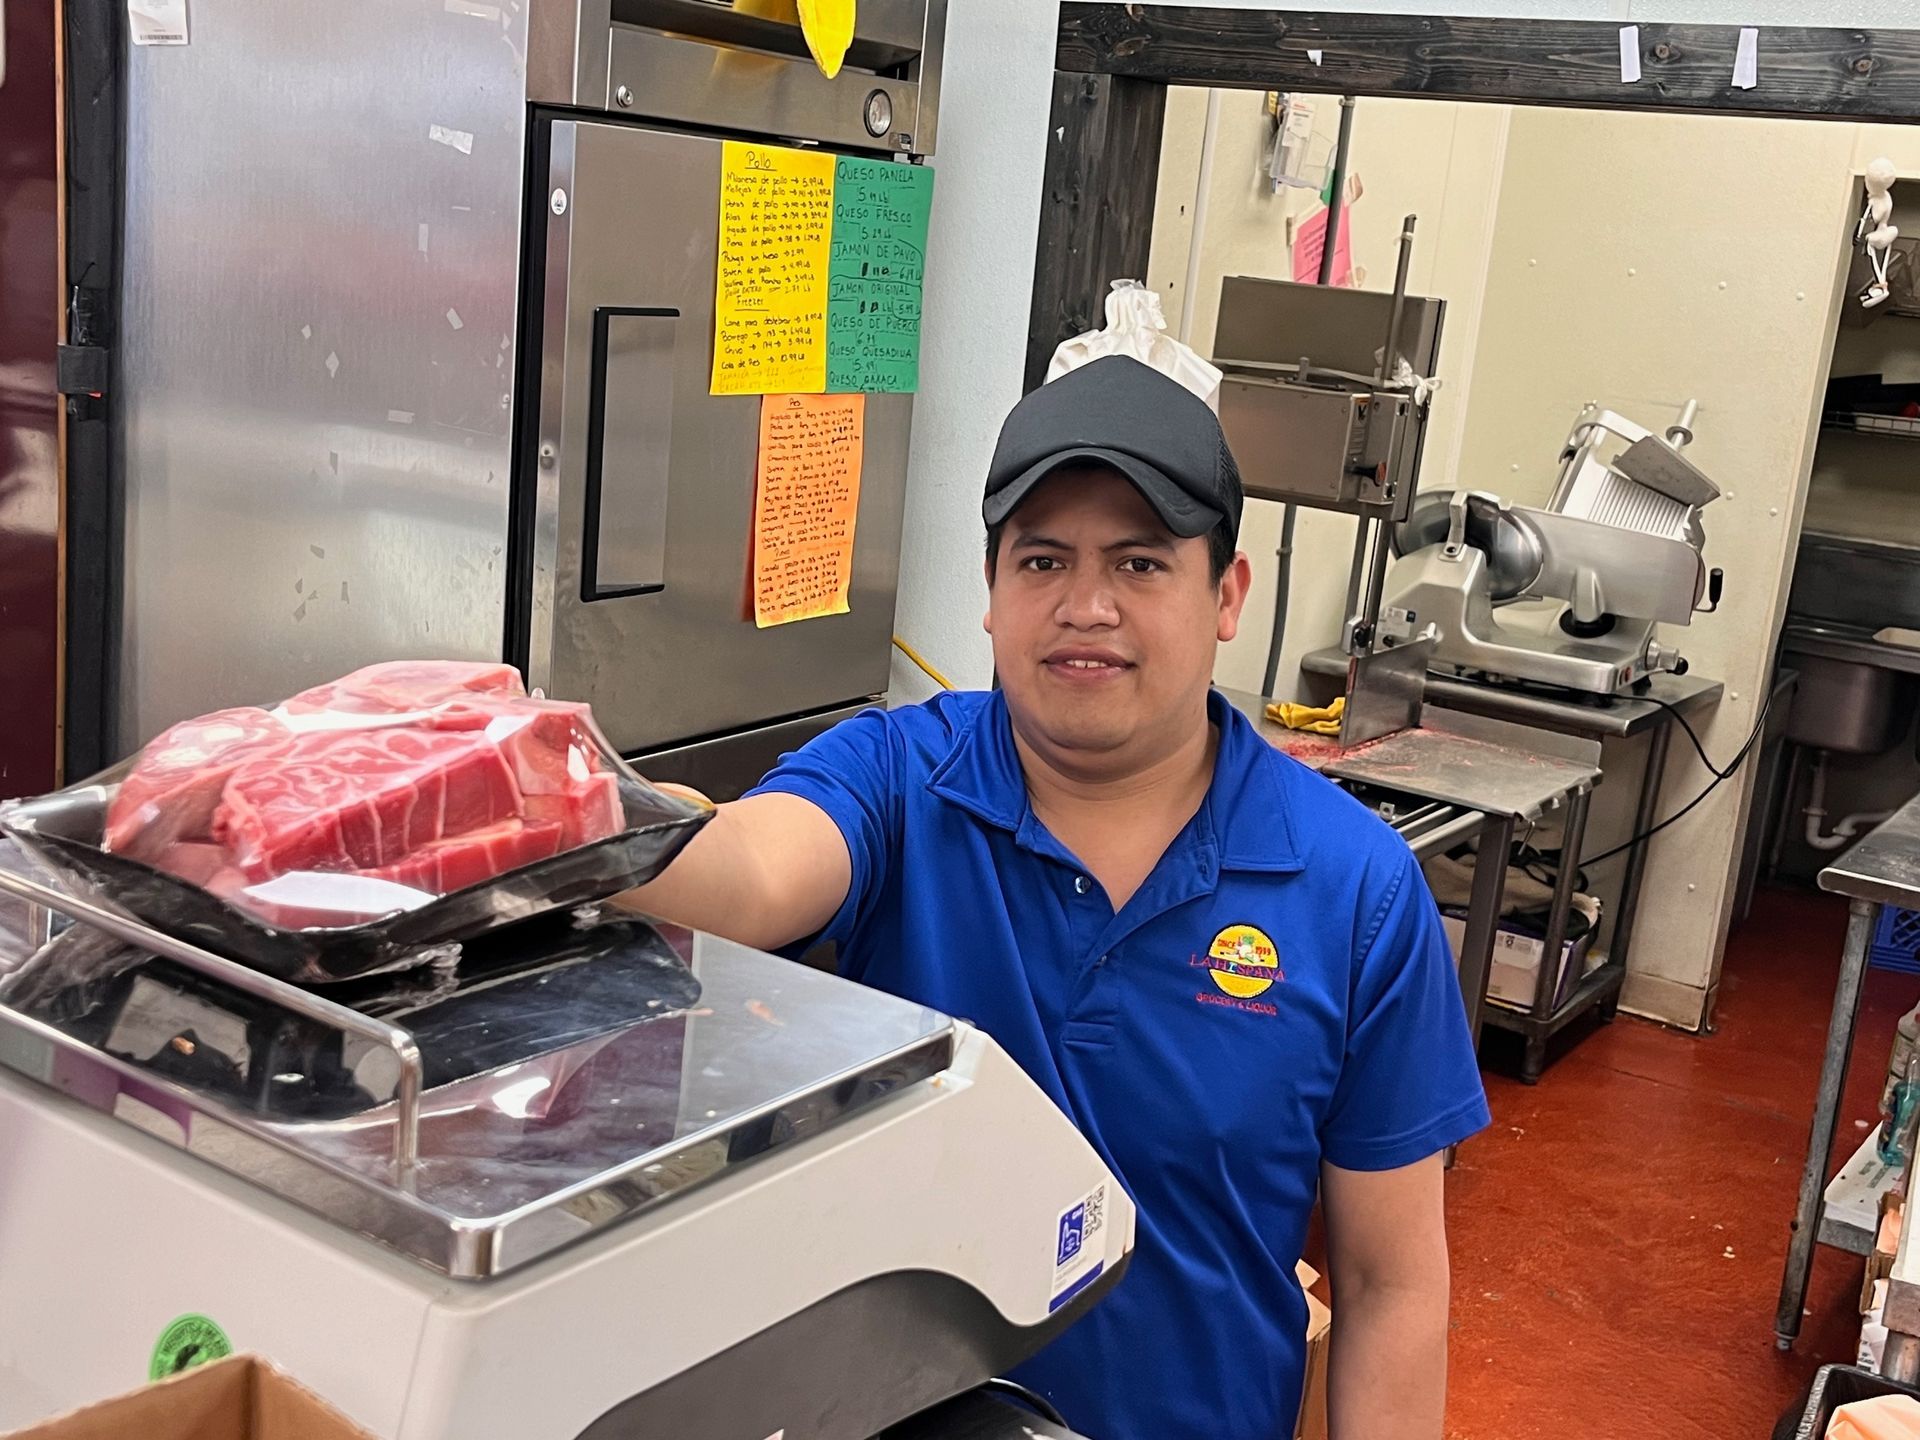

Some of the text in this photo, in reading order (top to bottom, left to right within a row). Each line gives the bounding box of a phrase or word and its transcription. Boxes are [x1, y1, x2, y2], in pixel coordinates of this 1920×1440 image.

[745, 151, 771, 169] Pollo
[838, 161, 913, 182] QUESO PANELA
[836, 204, 912, 223] QUESO FRESCO
[832, 241, 916, 262] JAMON DE PAVO
[832, 282, 910, 298] JAMON ORIGINAL
[831, 313, 917, 332] QUESO DE PUERCO
[829, 341, 856, 357] QUESO
[829, 371, 857, 386] QUESO
[864, 375, 897, 386] OAXACA
[1190, 953, 1211, 968] LA
[1246, 1002, 1277, 1016] LIQUOR
